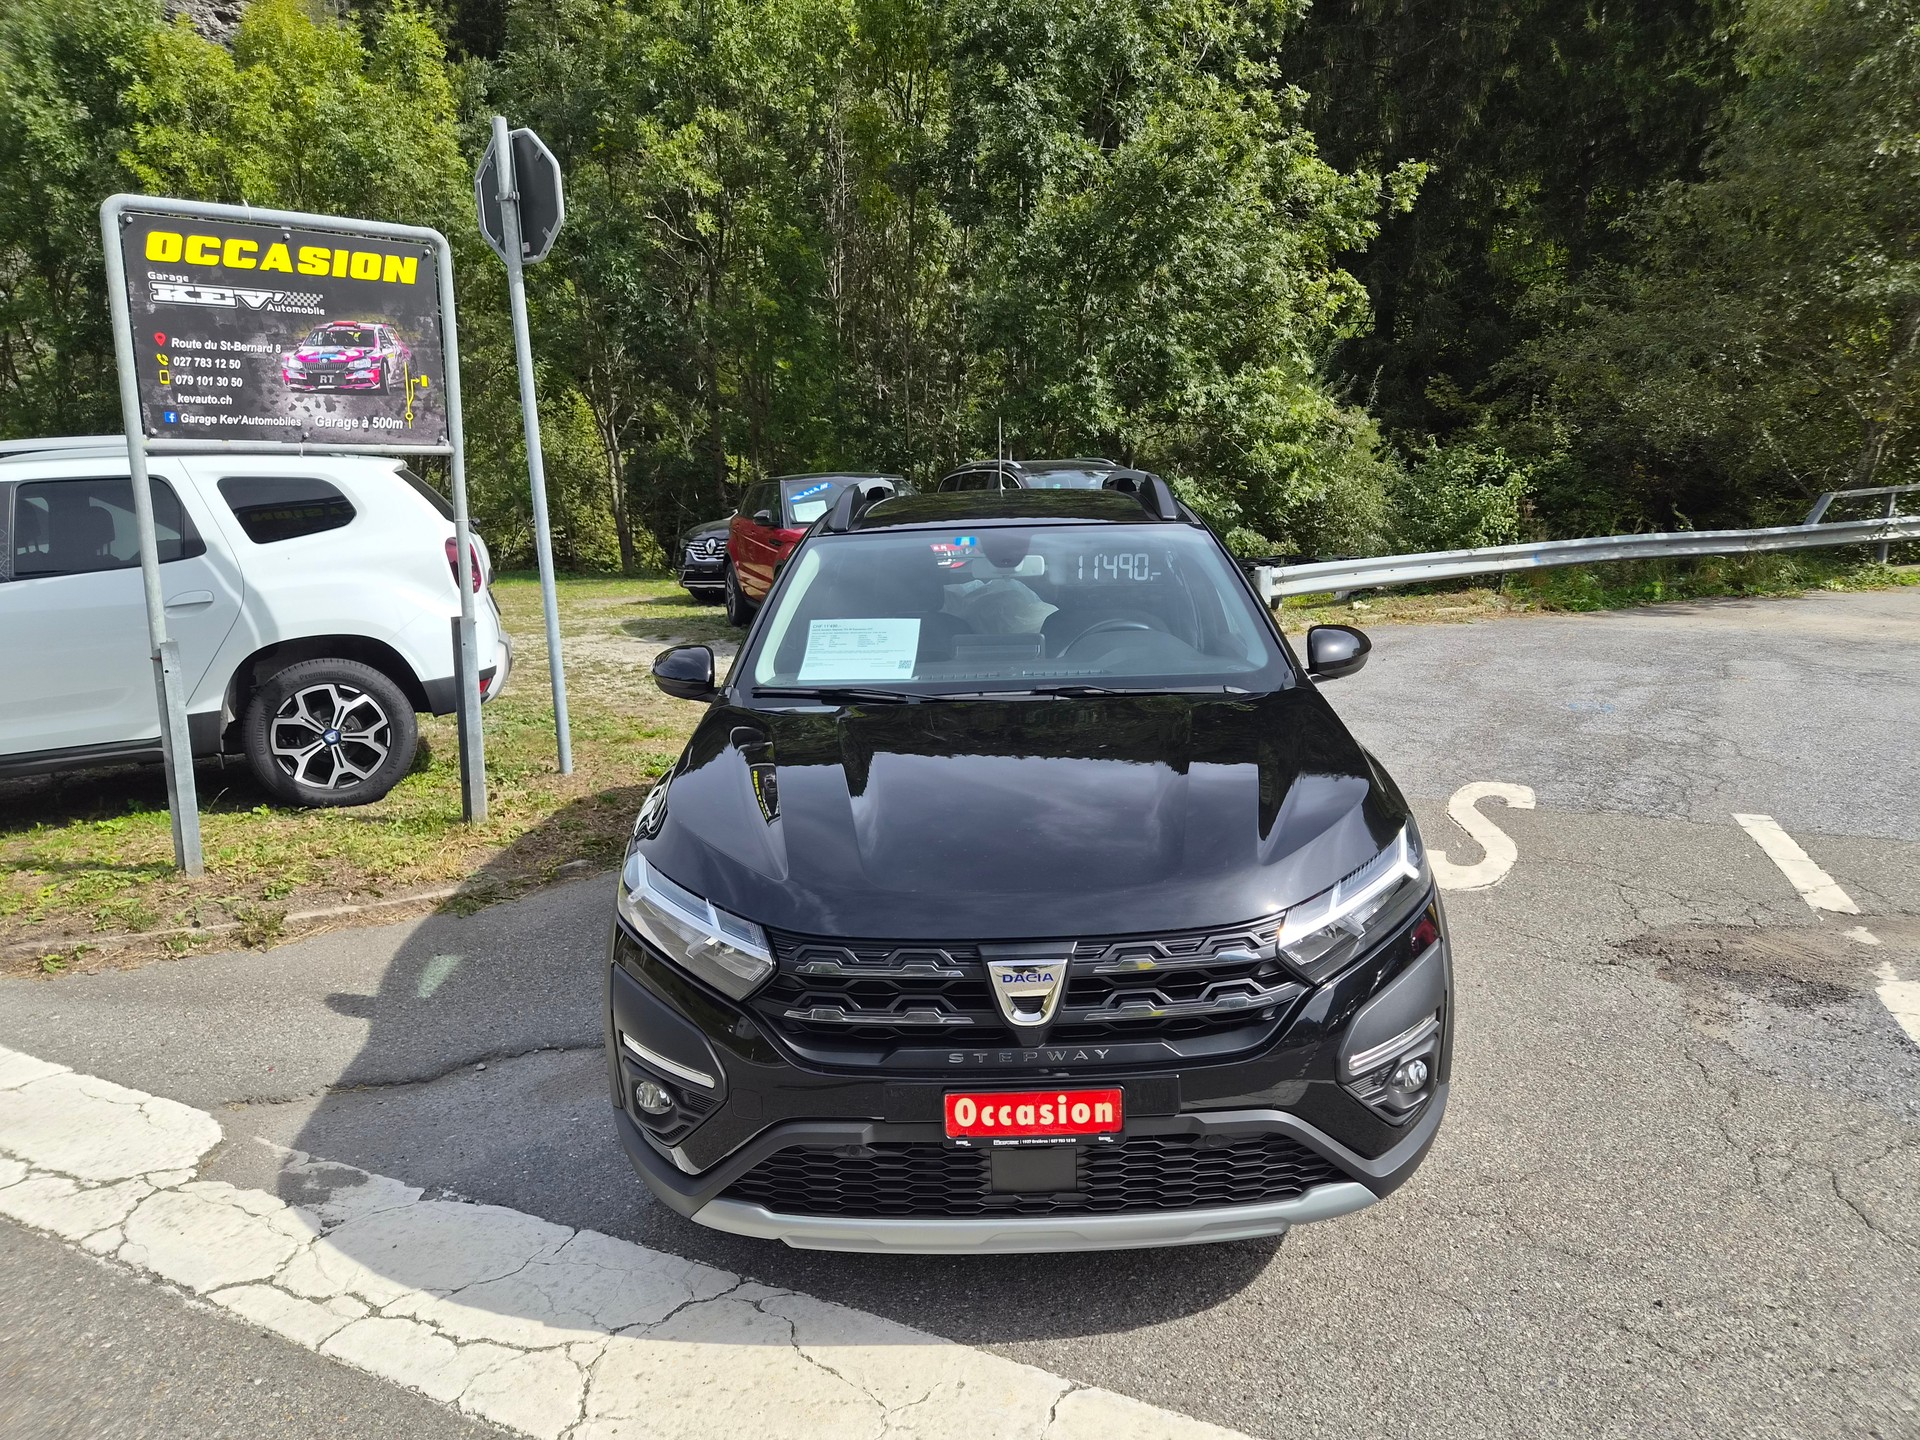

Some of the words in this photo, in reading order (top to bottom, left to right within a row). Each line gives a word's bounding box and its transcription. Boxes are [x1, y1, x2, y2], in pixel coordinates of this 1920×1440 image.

[144, 231, 418, 285] OCCASION
[147, 271, 189, 284] Garage
[266, 303, 326, 316] Automobile
[171, 337, 202, 350] Route
[204, 340, 218, 350] du
[220, 341, 273, 353] St-Bernard
[275, 344, 282, 354] 8
[173, 356, 192, 368] 027
[194, 357, 212, 368] 783
[215, 358, 227, 369] 12
[229, 359, 241, 370] 50
[175, 374, 194, 386] 079
[196, 375, 214, 386] 101
[216, 376, 229, 387] 30
[231, 377, 243, 388] 50
[319, 374, 335, 384] RT
[177, 393, 233, 405] kevauto.ch
[180, 413, 218, 427] Garage
[315, 415, 359, 431] Garage
[363, 415, 369, 429] à
[372, 416, 404, 429] 500m
[1001, 972, 1054, 983] DACIA
[948, 1048, 1109, 1063] STEPWAY
[954, 1094, 1113, 1127] Occasion
